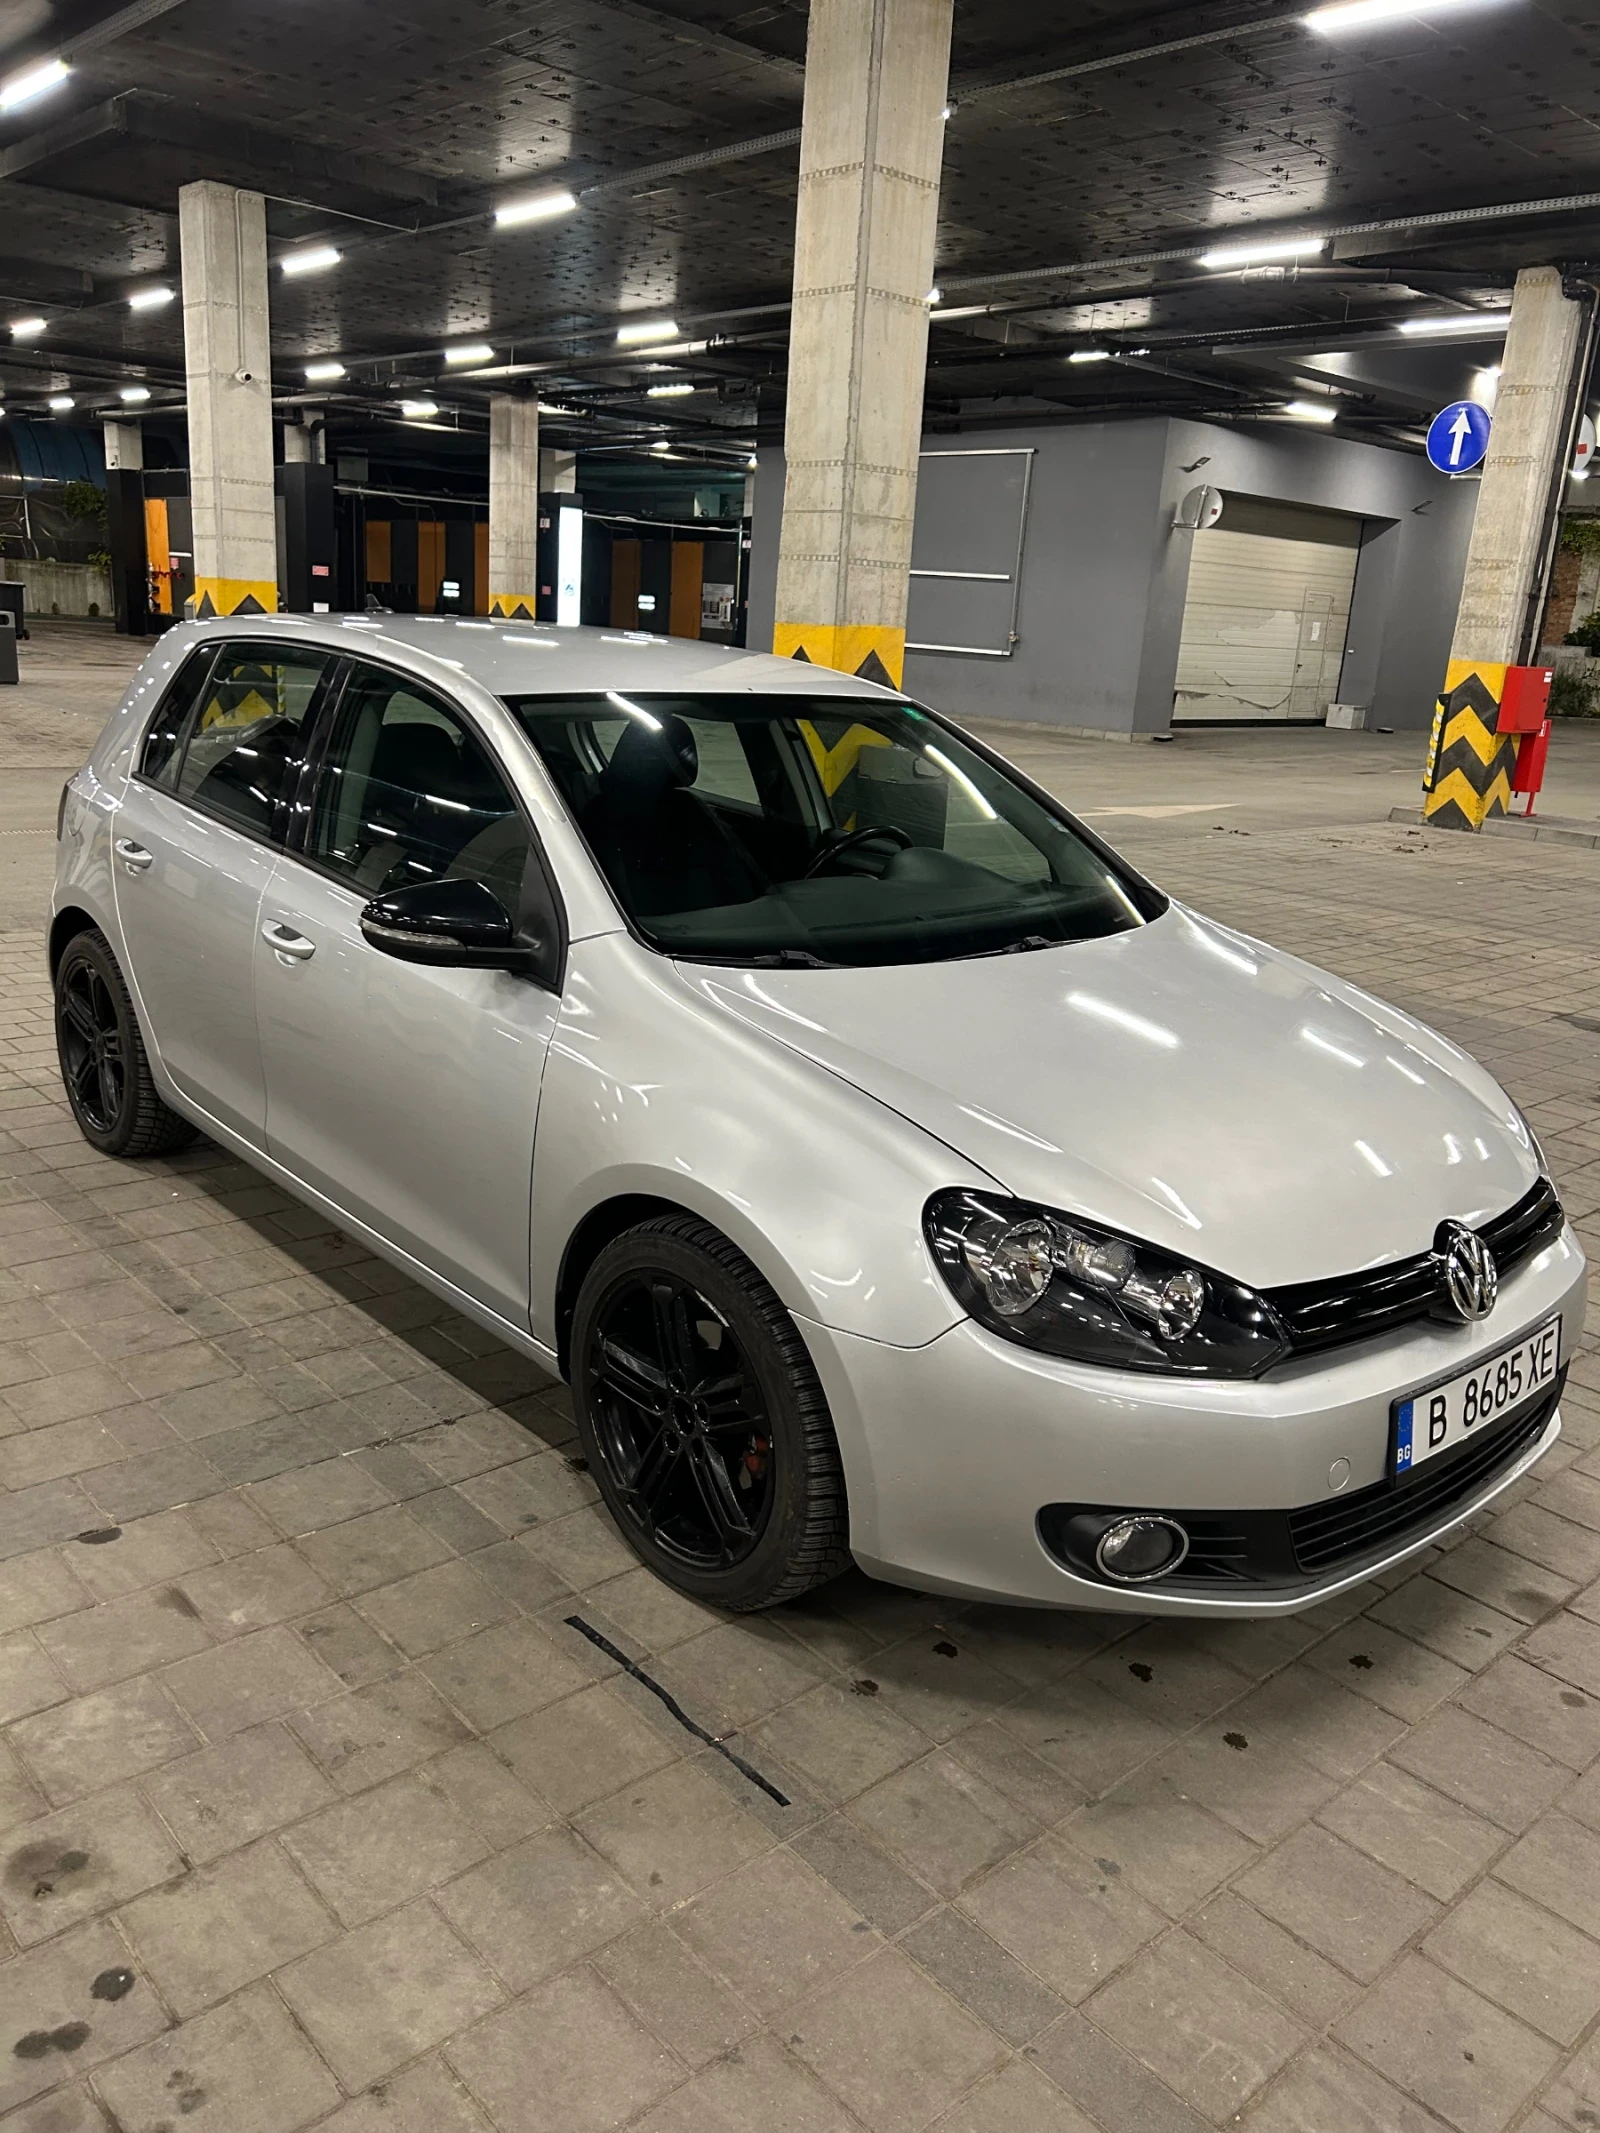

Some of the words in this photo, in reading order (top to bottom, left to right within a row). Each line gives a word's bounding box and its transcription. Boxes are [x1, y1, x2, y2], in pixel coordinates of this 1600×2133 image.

[1429, 1395, 1447, 1448] B
[1463, 1350, 1523, 1427] 8685
[1527, 1329, 1554, 1389] XE
[1397, 1444, 1411, 1464] BG
